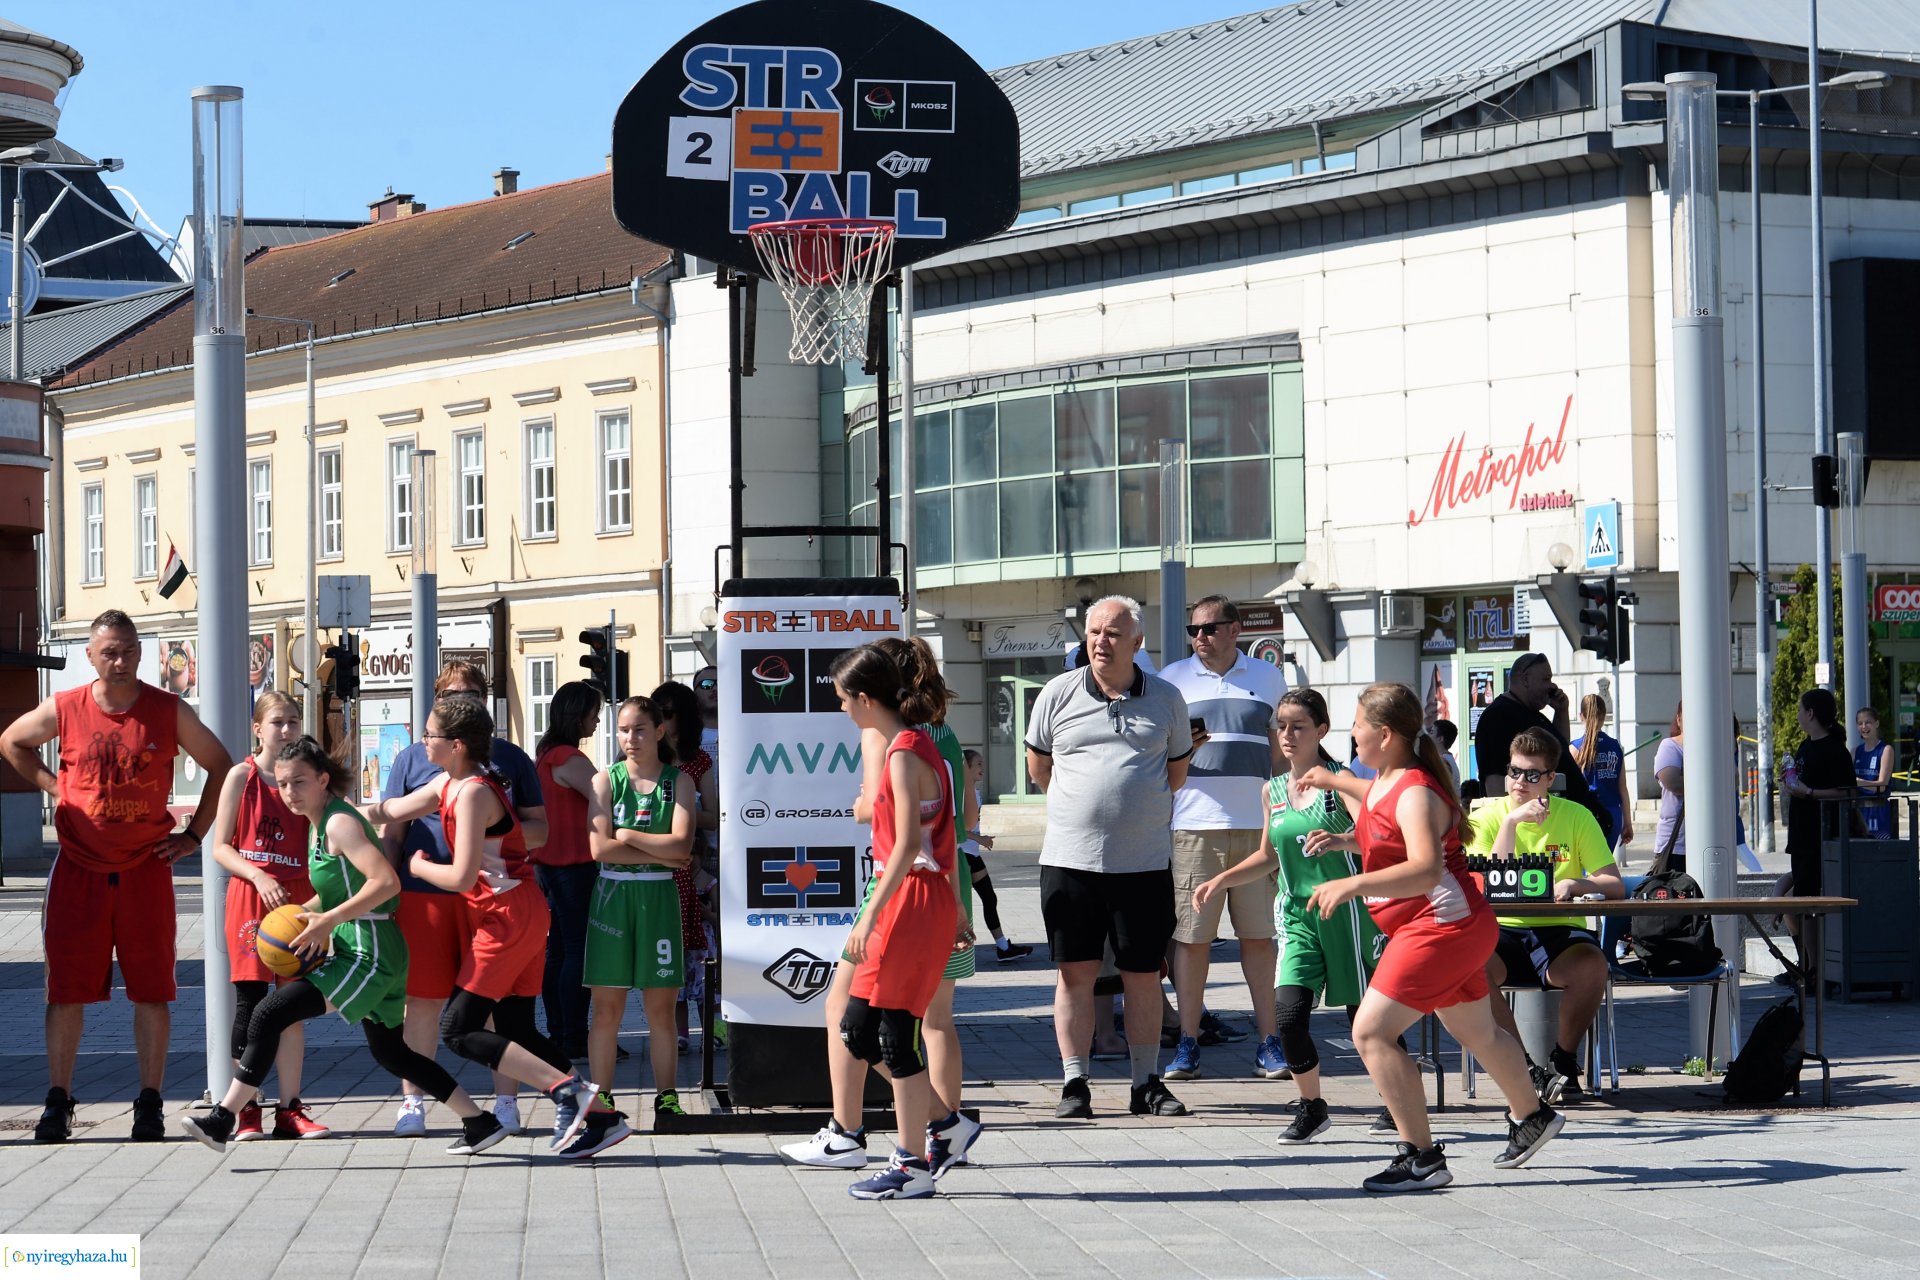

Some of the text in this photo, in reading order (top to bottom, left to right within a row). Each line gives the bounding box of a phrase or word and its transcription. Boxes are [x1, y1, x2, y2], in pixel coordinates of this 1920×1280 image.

[679, 43, 842, 111] STR
[684, 132, 714, 165] 2
[888, 157, 931, 173] TOTI
[730, 171, 946, 238] BALL
[1695, 308, 1709, 316] 36
[211, 326, 225, 335] 36
[1409, 393, 1573, 527] Metropol
[722, 609, 899, 633] STREETBALL
[988, 625, 1039, 654] Firenze
[745, 808, 766, 819] GB
[1521, 869, 1547, 898] 9
[746, 912, 858, 927] STREETBA
[656, 938, 673, 965] 9
